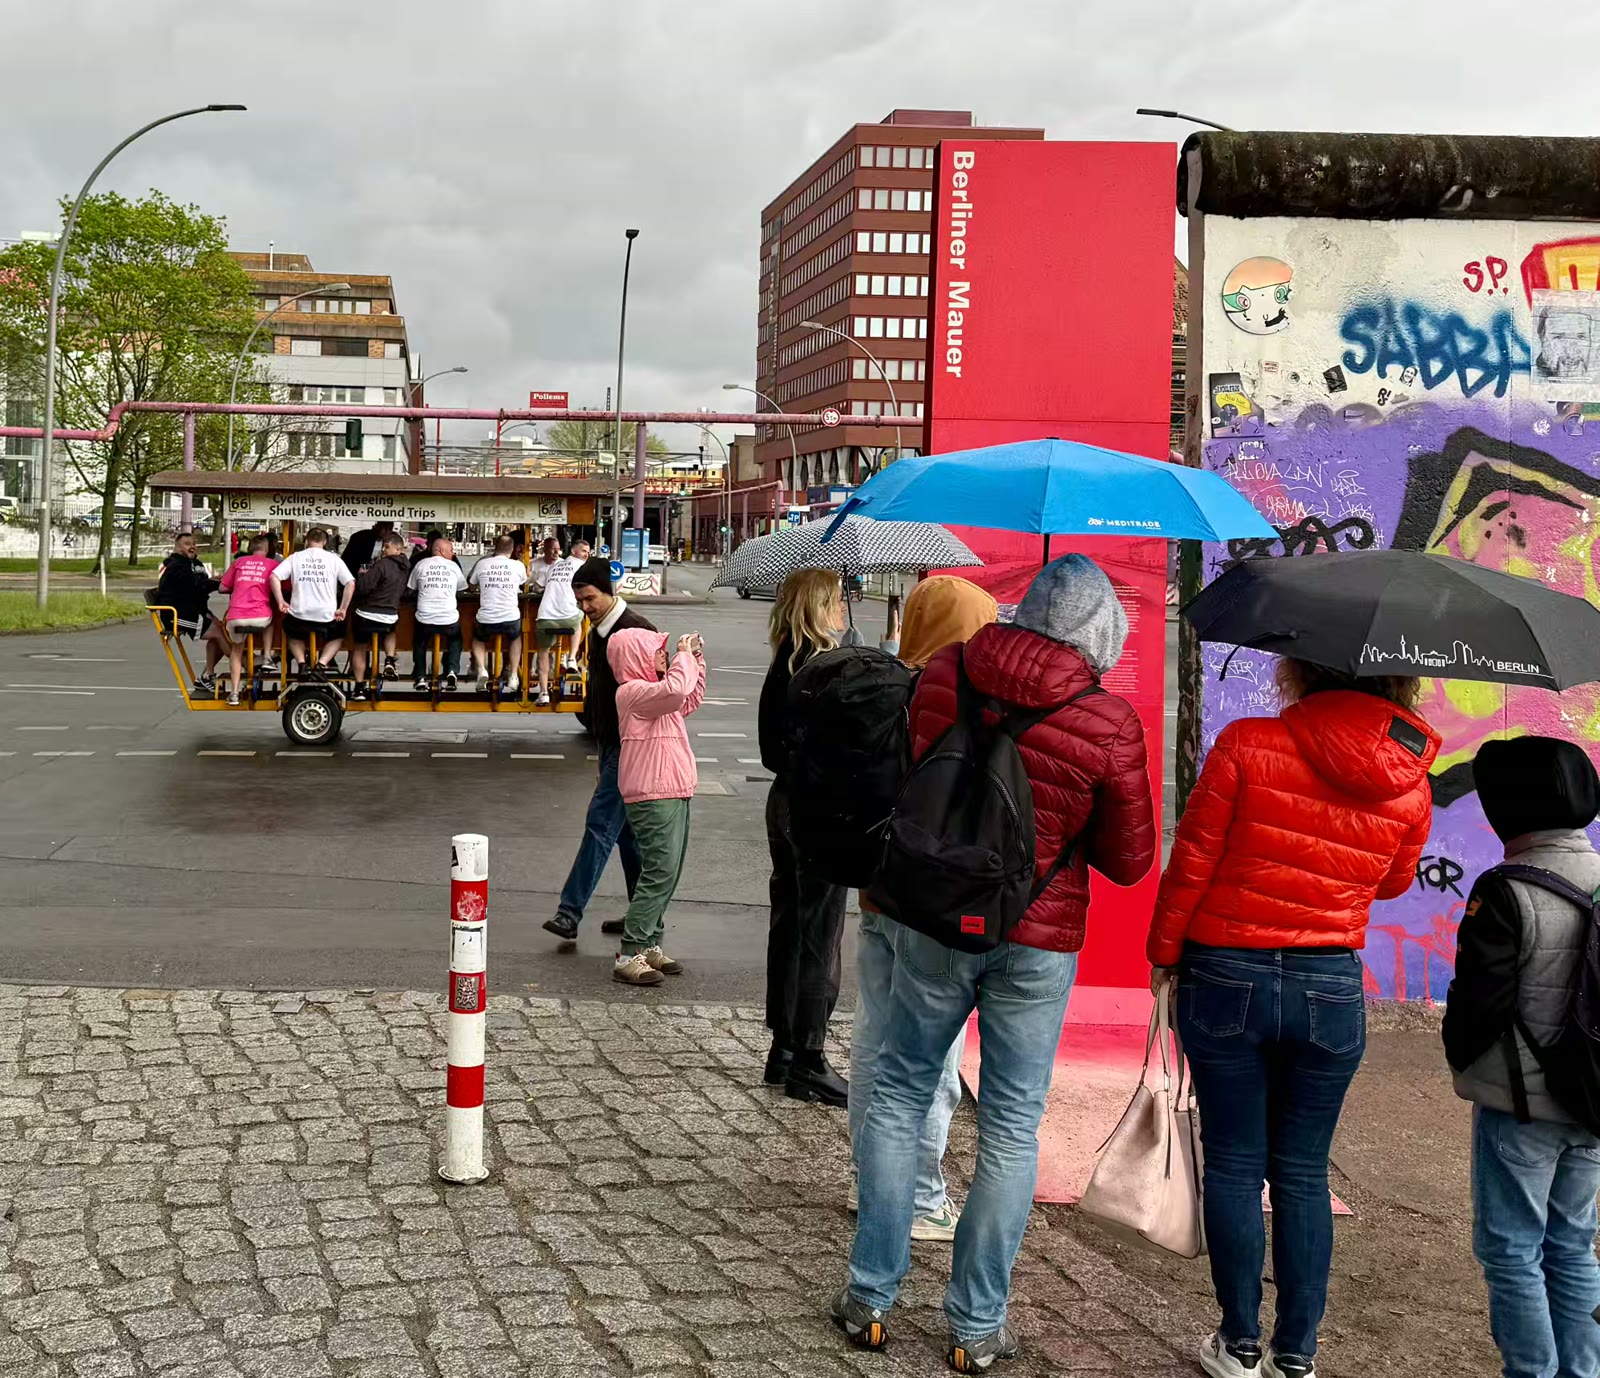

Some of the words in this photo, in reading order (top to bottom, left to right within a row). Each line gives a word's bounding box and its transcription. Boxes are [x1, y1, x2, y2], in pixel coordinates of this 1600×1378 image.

[949, 151, 975, 270] Berliner
[946, 281, 971, 378] Mauer
[231, 499, 248, 509] 66
[273, 493, 315, 507] Cycling
[324, 494, 394, 508] Sightseeing
[269, 505, 312, 516] Shuttle
[315, 506, 358, 517] Service
[367, 507, 405, 517] Round
[407, 507, 436, 520] Trips
[1106, 519, 1161, 528] MEDITRADE
[1497, 661, 1539, 674] BERLIN
[1415, 855, 1465, 898] FOR
